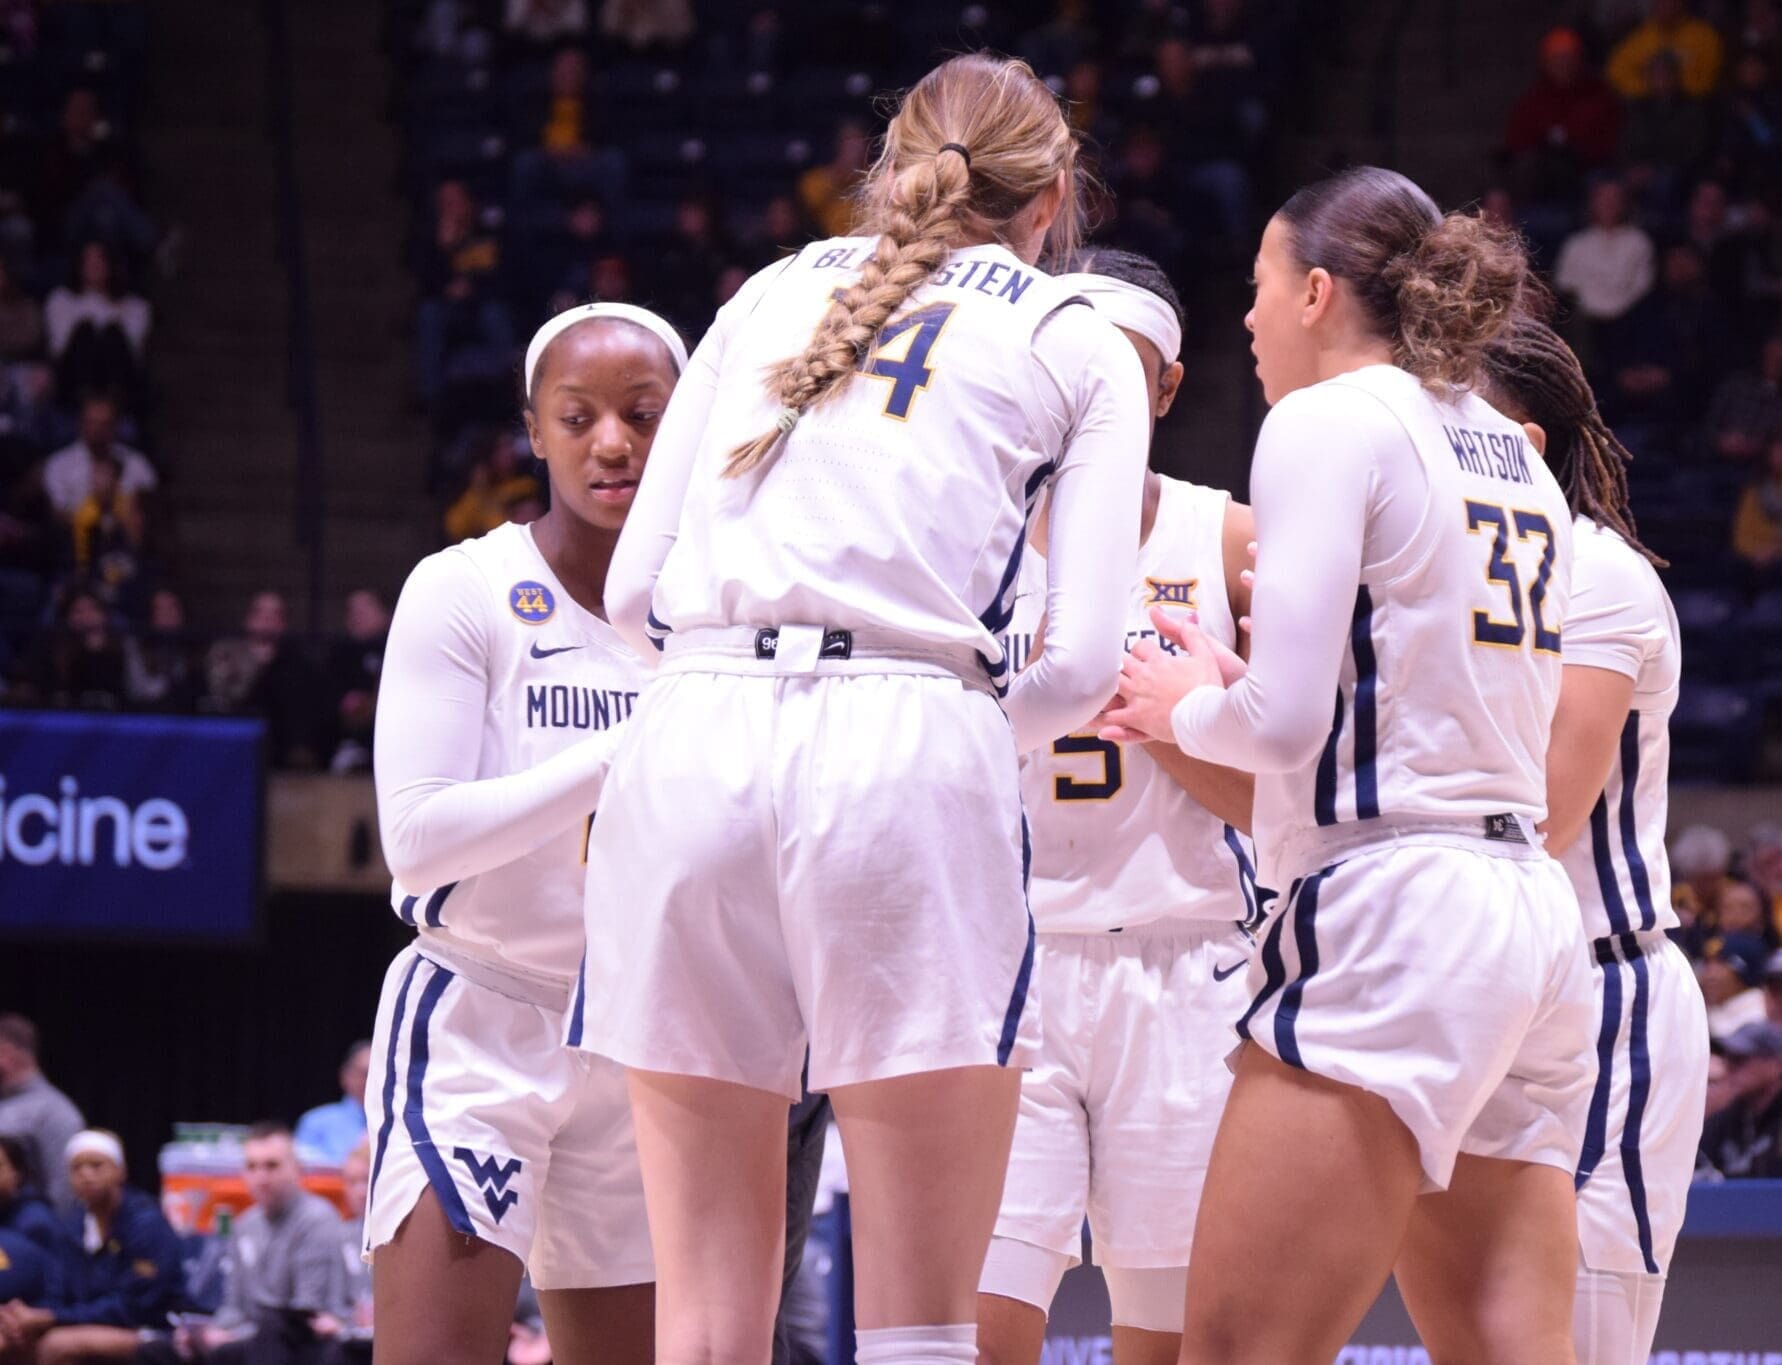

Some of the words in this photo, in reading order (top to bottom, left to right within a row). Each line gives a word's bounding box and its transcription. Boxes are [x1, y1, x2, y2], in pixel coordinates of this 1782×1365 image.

[812, 248, 1034, 305] BLSTEN
[808, 287, 961, 422] 4
[1443, 425, 1534, 486] WATSON
[516, 595, 548, 613] 44
[1147, 579, 1198, 608] XII
[1463, 497, 1562, 659] 32
[1053, 732, 1125, 803] 5
